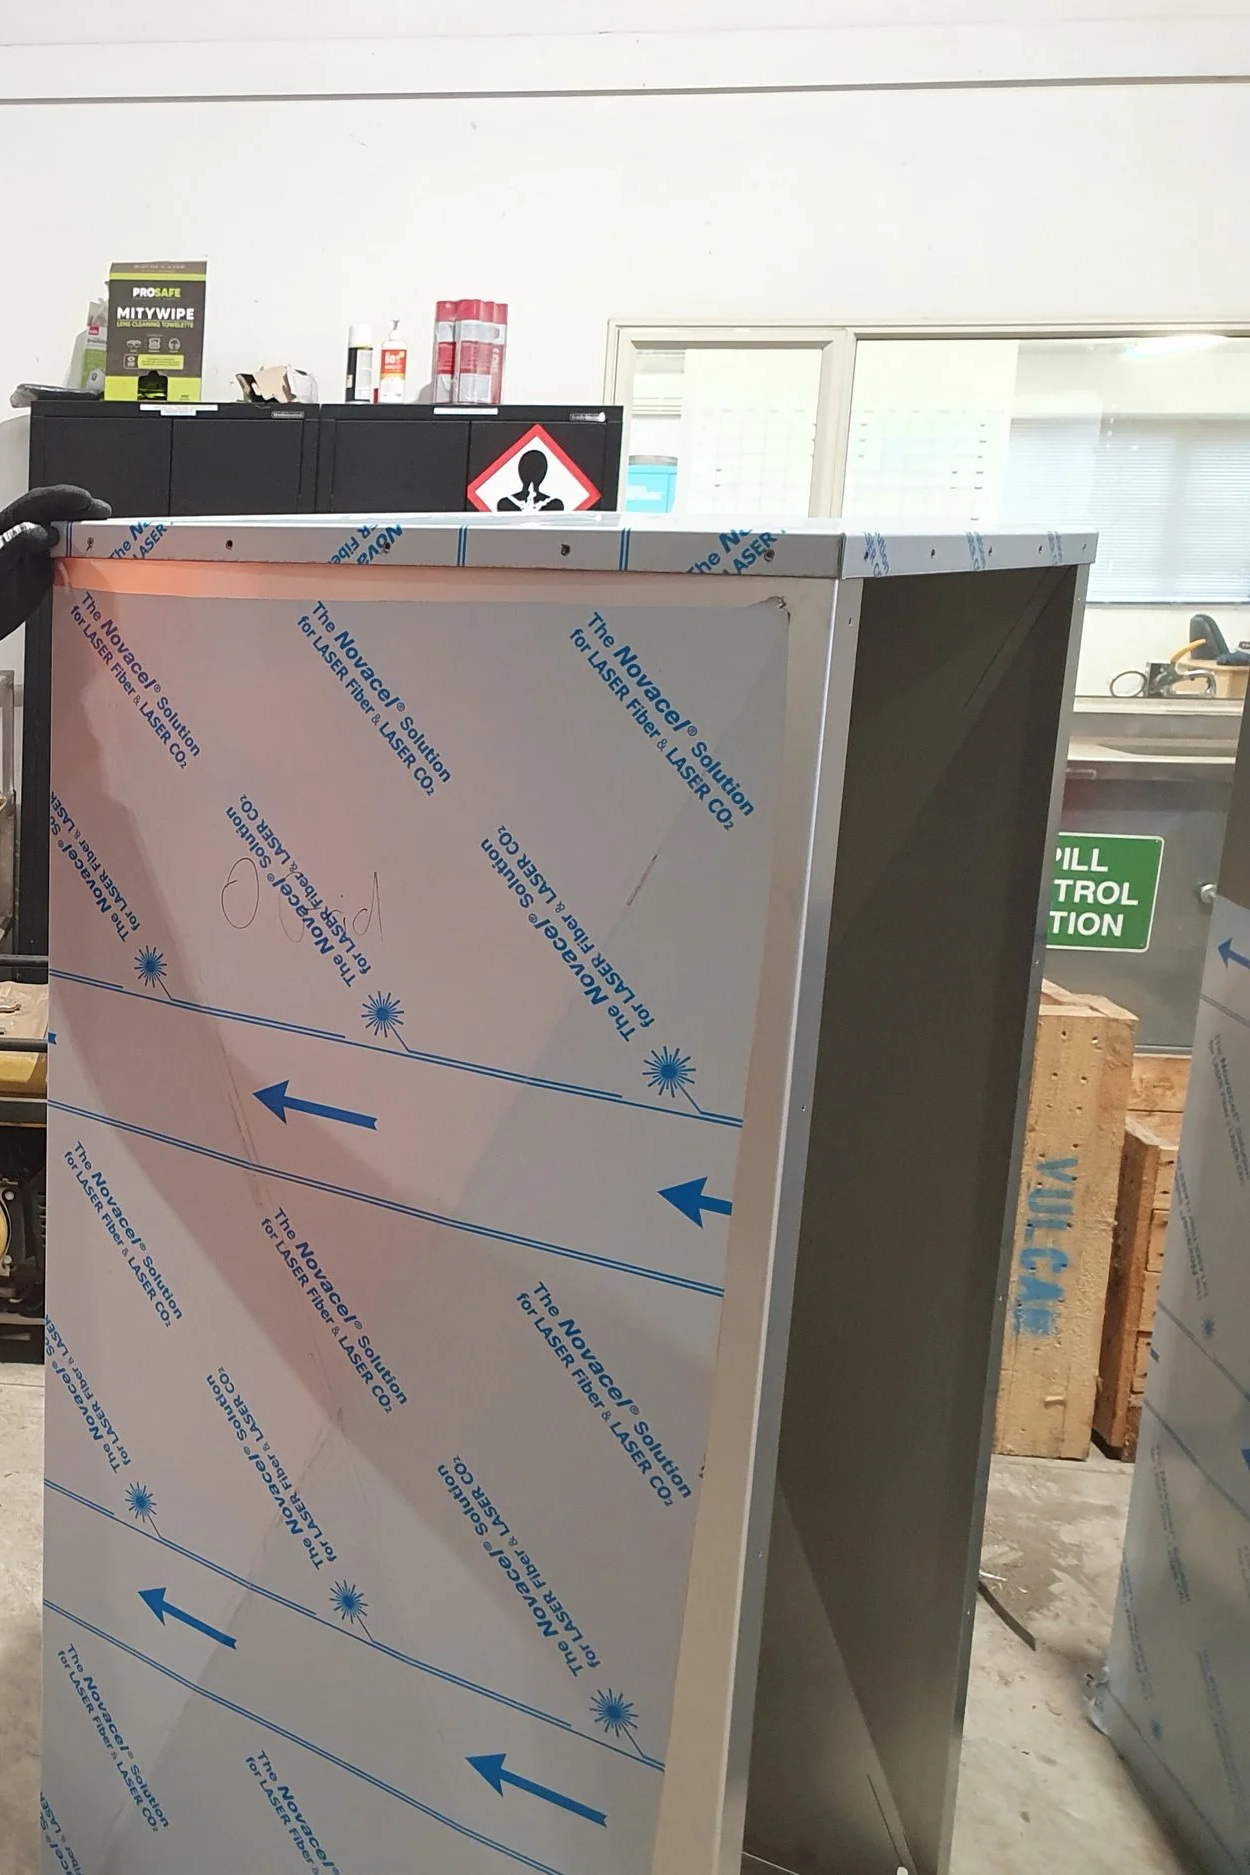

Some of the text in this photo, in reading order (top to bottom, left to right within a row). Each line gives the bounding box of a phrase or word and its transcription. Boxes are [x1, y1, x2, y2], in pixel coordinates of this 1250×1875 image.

[116, 307, 195, 320] MITYWIPE
[133, 287, 181, 298] PROSAFE
[70, 605, 86, 625] for
[83, 624, 113, 666] LASER
[110, 662, 136, 695] Fiber
[139, 702, 171, 745] LASER
[82, 591, 101, 621] The
[157, 697, 200, 757] Solution
[297, 616, 316, 637] for
[313, 635, 349, 682] LASER
[345, 678, 375, 714] Fiber
[379, 721, 416, 769] LASER
[313, 600, 335, 633] The
[400, 716, 451, 783] Solution
[570, 628, 591, 653] for
[587, 650, 630, 702] LASER
[626, 698, 661, 738] Fiber
[665, 747, 711, 800] LASER
[588, 611, 614, 648] The
[691, 741, 754, 816] Solution
[78, 840, 101, 872] Fiber
[226, 807, 271, 868] Solution
[256, 819, 291, 865] LASER
[99, 869, 127, 912] LASER
[295, 872, 323, 910] Fiber
[481, 838, 534, 908] Solution
[517, 853, 557, 904] LASER
[111, 912, 129, 942] The
[125, 911, 140, 931] for
[320, 906, 356, 953] LASER
[561, 914, 595, 954] Fiber
[333, 954, 356, 987] The
[352, 953, 371, 974] for
[591, 953, 635, 1004] LASER
[608, 1005, 636, 1042] The
[631, 1003, 655, 1028] for
[64, 1151, 78, 1170] for
[76, 1170, 103, 1214] LASER
[101, 1213, 124, 1245] Fiber
[128, 1256, 156, 1301] LASER
[75, 1141, 92, 1171] The
[143, 1256, 182, 1319] Solution
[261, 1218, 278, 1239] for
[275, 1240, 309, 1288] LASER
[306, 1287, 335, 1323] Fiber
[338, 1336, 374, 1384] LASER
[275, 1207, 296, 1240] The
[358, 1335, 407, 1404] Solution
[72, 1367, 94, 1400] Fiber
[516, 1293, 538, 1315] for
[534, 1317, 575, 1369] LASER
[571, 1368, 605, 1408] Fiber
[609, 1421, 652, 1475] LASER
[534, 1281, 559, 1317] The
[634, 1421, 692, 1498] Solution
[92, 1400, 119, 1444] LASER
[206, 1374, 247, 1441] Solution
[233, 1394, 264, 1442] LASER
[103, 1443, 120, 1472] The
[116, 1446, 131, 1465] for
[267, 1454, 292, 1491] Fiber
[290, 1491, 323, 1539] LASER
[437, 1464, 488, 1536] Solution
[471, 1485, 510, 1537] LASER
[303, 1537, 324, 1570] The
[319, 1541, 337, 1562] for
[514, 1550, 546, 1589] Fiber
[543, 1590, 583, 1642] LASER
[558, 1641, 583, 1677] The
[579, 1644, 601, 1668] for
[58, 1650, 71, 1669] for
[69, 1671, 94, 1714] LASER
[92, 1715, 114, 1749] Fiber
[116, 1761, 143, 1806] LASER
[67, 1643, 84, 1673] The
[130, 1764, 169, 1827] Solution
[258, 1750, 277, 1781] The
[246, 1757, 262, 1777] for
[259, 1779, 291, 1826] LASER
[288, 1828, 315, 1864] Fiber
